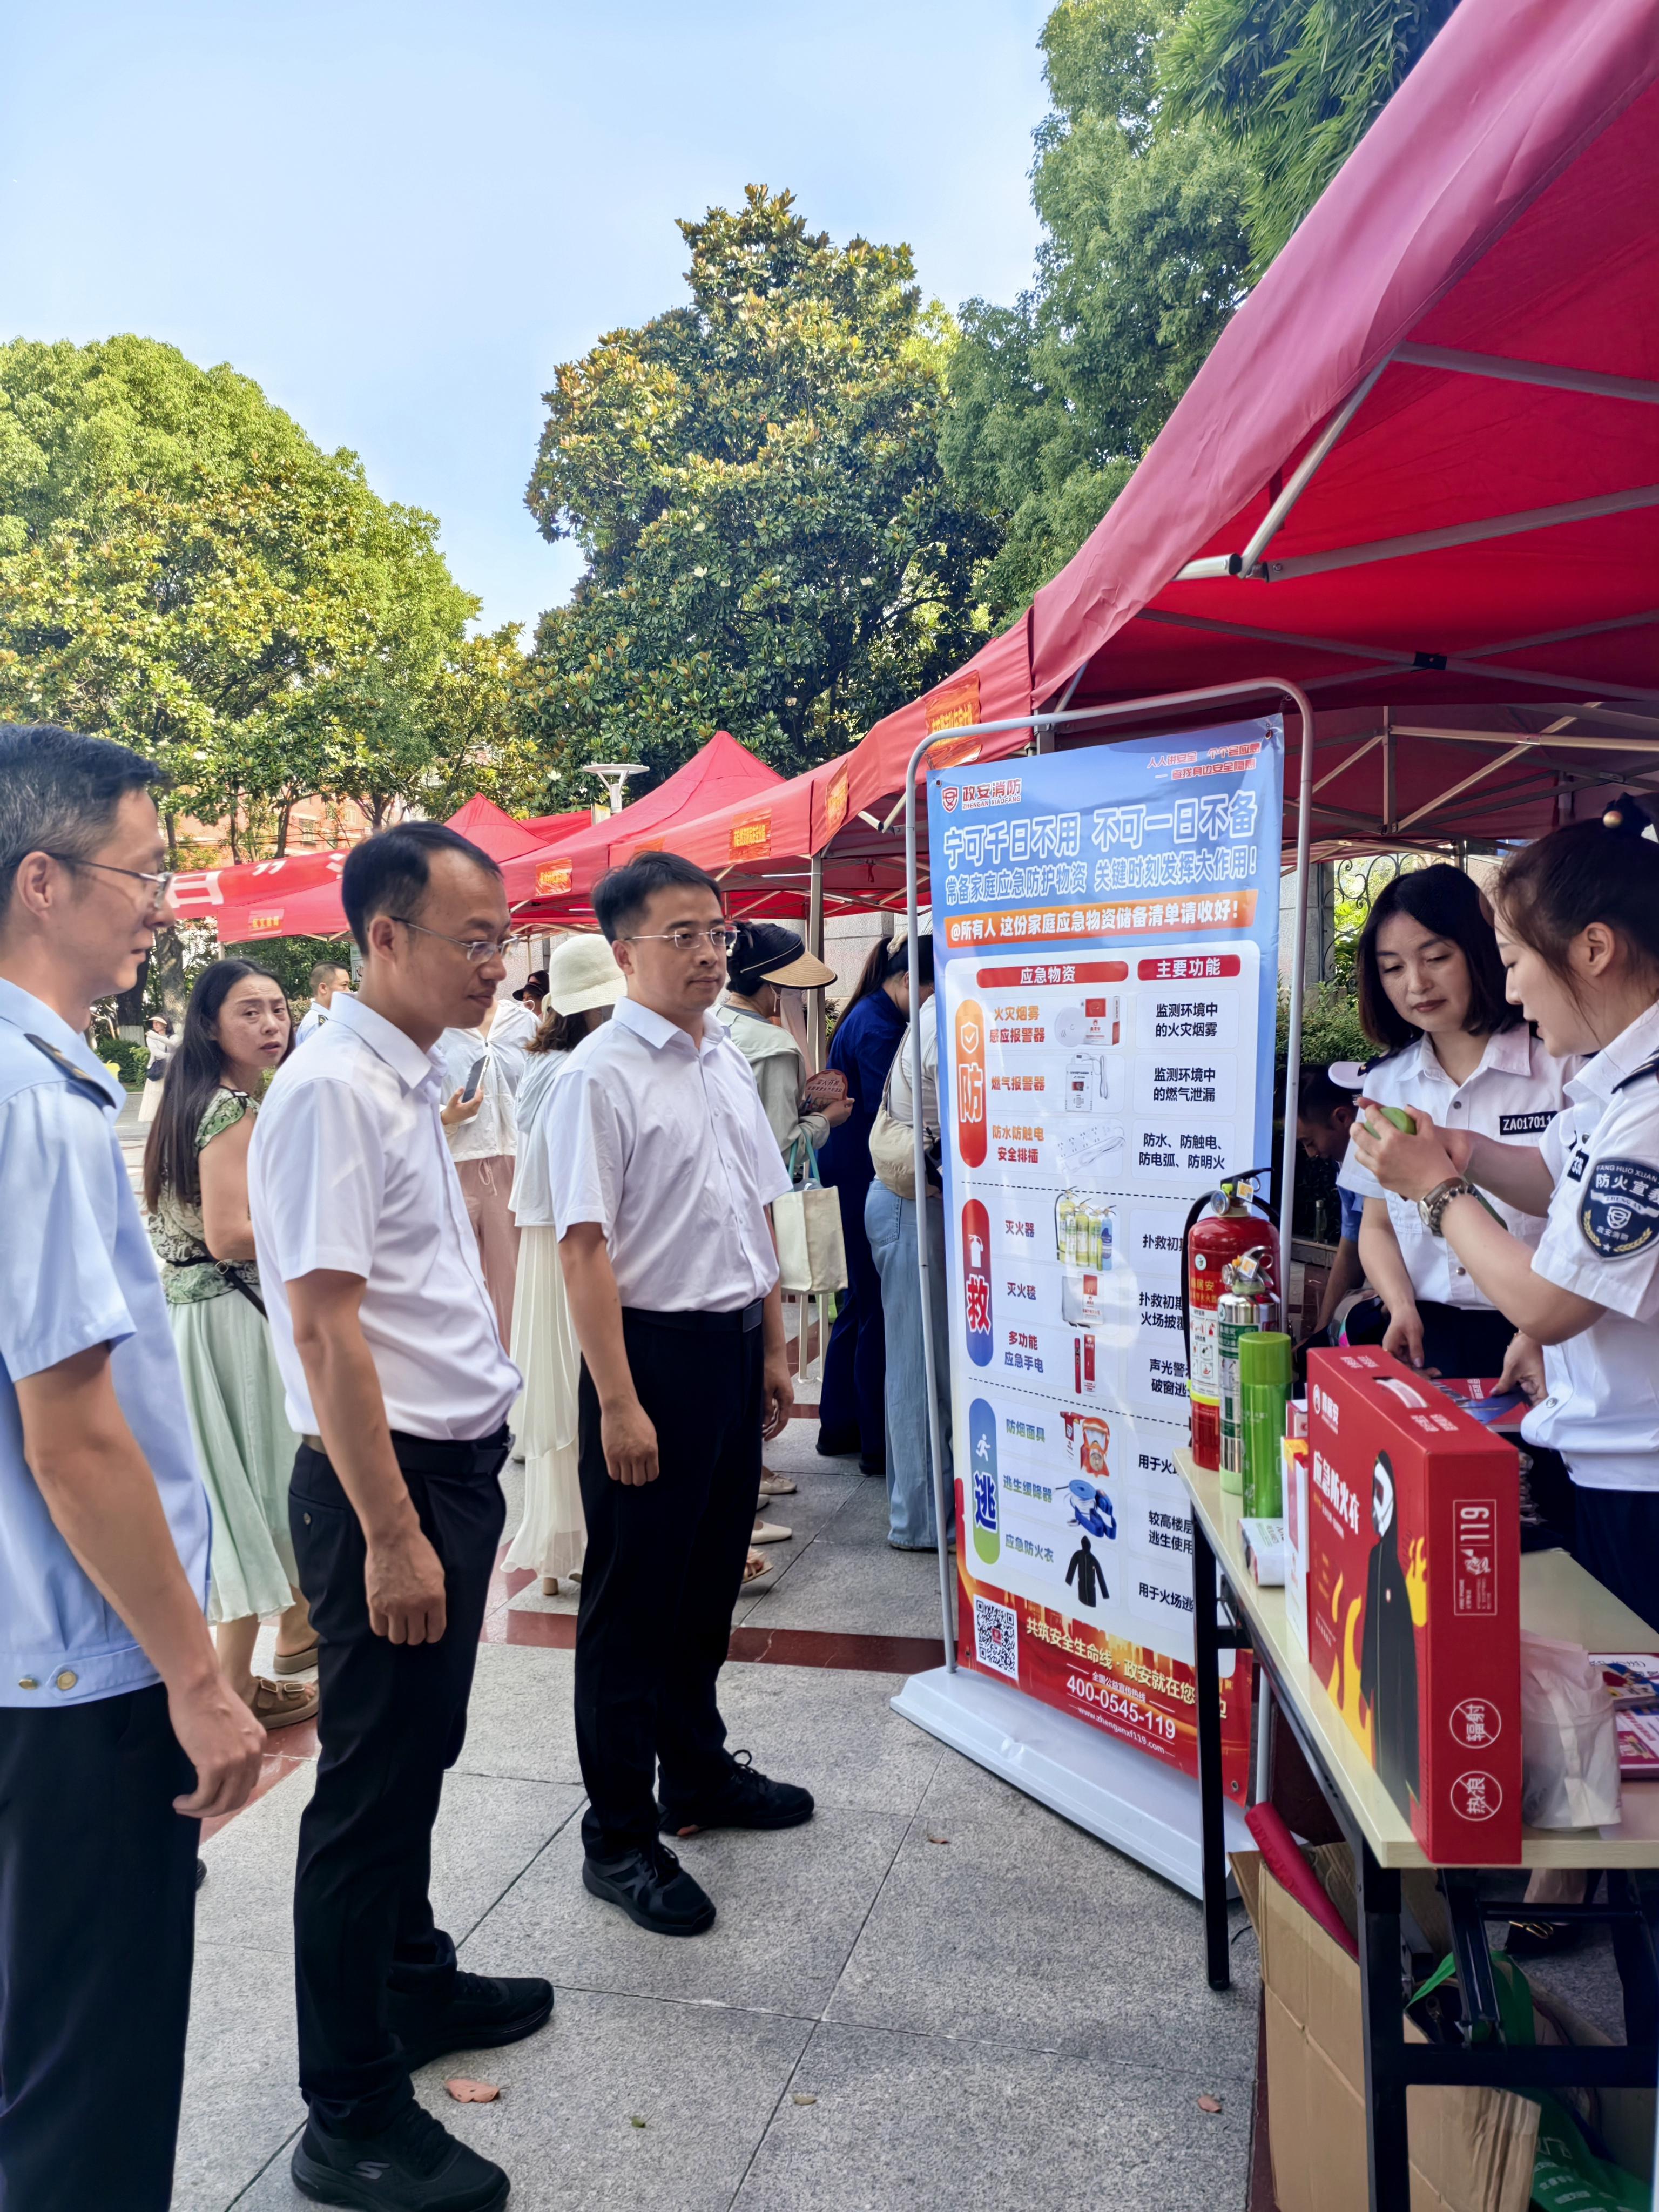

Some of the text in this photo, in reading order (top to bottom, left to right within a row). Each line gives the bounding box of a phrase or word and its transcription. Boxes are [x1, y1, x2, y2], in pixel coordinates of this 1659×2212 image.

[1147, 742, 1262, 769] 人人讲安全 个个会应急
[1171, 758, 1257, 780] 查找身边安全隐患
[962, 778, 1022, 802] 政安消防
[962, 795, 1021, 810] ZHENGAN XIAOFANG
[943, 790, 1258, 870] 宁可千日不用 不可一日不备
[946, 845, 1257, 906] 常备家庭应急防护物资 关键时刻发挥大作用！
[950, 899, 1239, 942] @所有人 这份家庭应急物资储备清单请收好！
[1020, 965, 1076, 984] 应急物资
[1156, 958, 1221, 978] 主要功能
[994, 1005, 1040, 1021] 火灾烟雾
[1156, 1002, 1218, 1019] 监测环境中
[989, 1027, 1045, 1043] 感应报警器
[1155, 1022, 1218, 1037] 的火灾烟雾
[991, 1075, 1045, 1091] 燃气报警器
[1154, 1067, 1216, 1083] 监测环境中
[959, 1063, 983, 1123] 防
[1153, 1087, 1216, 1103] 的燃气泄漏
[992, 1125, 1044, 1142] 防水防触电
[1143, 1132, 1223, 1151] 防水、防触电、
[997, 1147, 1039, 1163] 安全排插
[1139, 1151, 1225, 1170] 防电弧、防明火
[1616, 1165, 1634, 1175] HUO
[1635, 1169, 1658, 1183] XUAN
[1004, 1219, 1035, 1238] 灭火器
[1007, 1281, 1037, 1301] 灭火毯
[965, 1273, 992, 1337] 救
[1008, 1330, 1038, 1351] 多功能
[1004, 1351, 1044, 1374] 应急手电
[1006, 1418, 1046, 1444] 防烟面具
[1003, 1473, 1053, 1505] 逃生缓降器
[974, 1469, 997, 1534] 逃
[1148, 1510, 1193, 1535] 较高楼层
[1460, 1507, 1491, 1541] 119
[1005, 1533, 1054, 1564] 应急防火衣
[1092, 1671, 1146, 1703] 全国公益宣传热线
[1067, 1675, 1176, 1739] 400-0545-119
[1078, 1707, 1165, 1755] www.zhenganxf119.com
[1465, 1704, 1485, 1742] 辐射
[1465, 1777, 1486, 1815] 热浪
